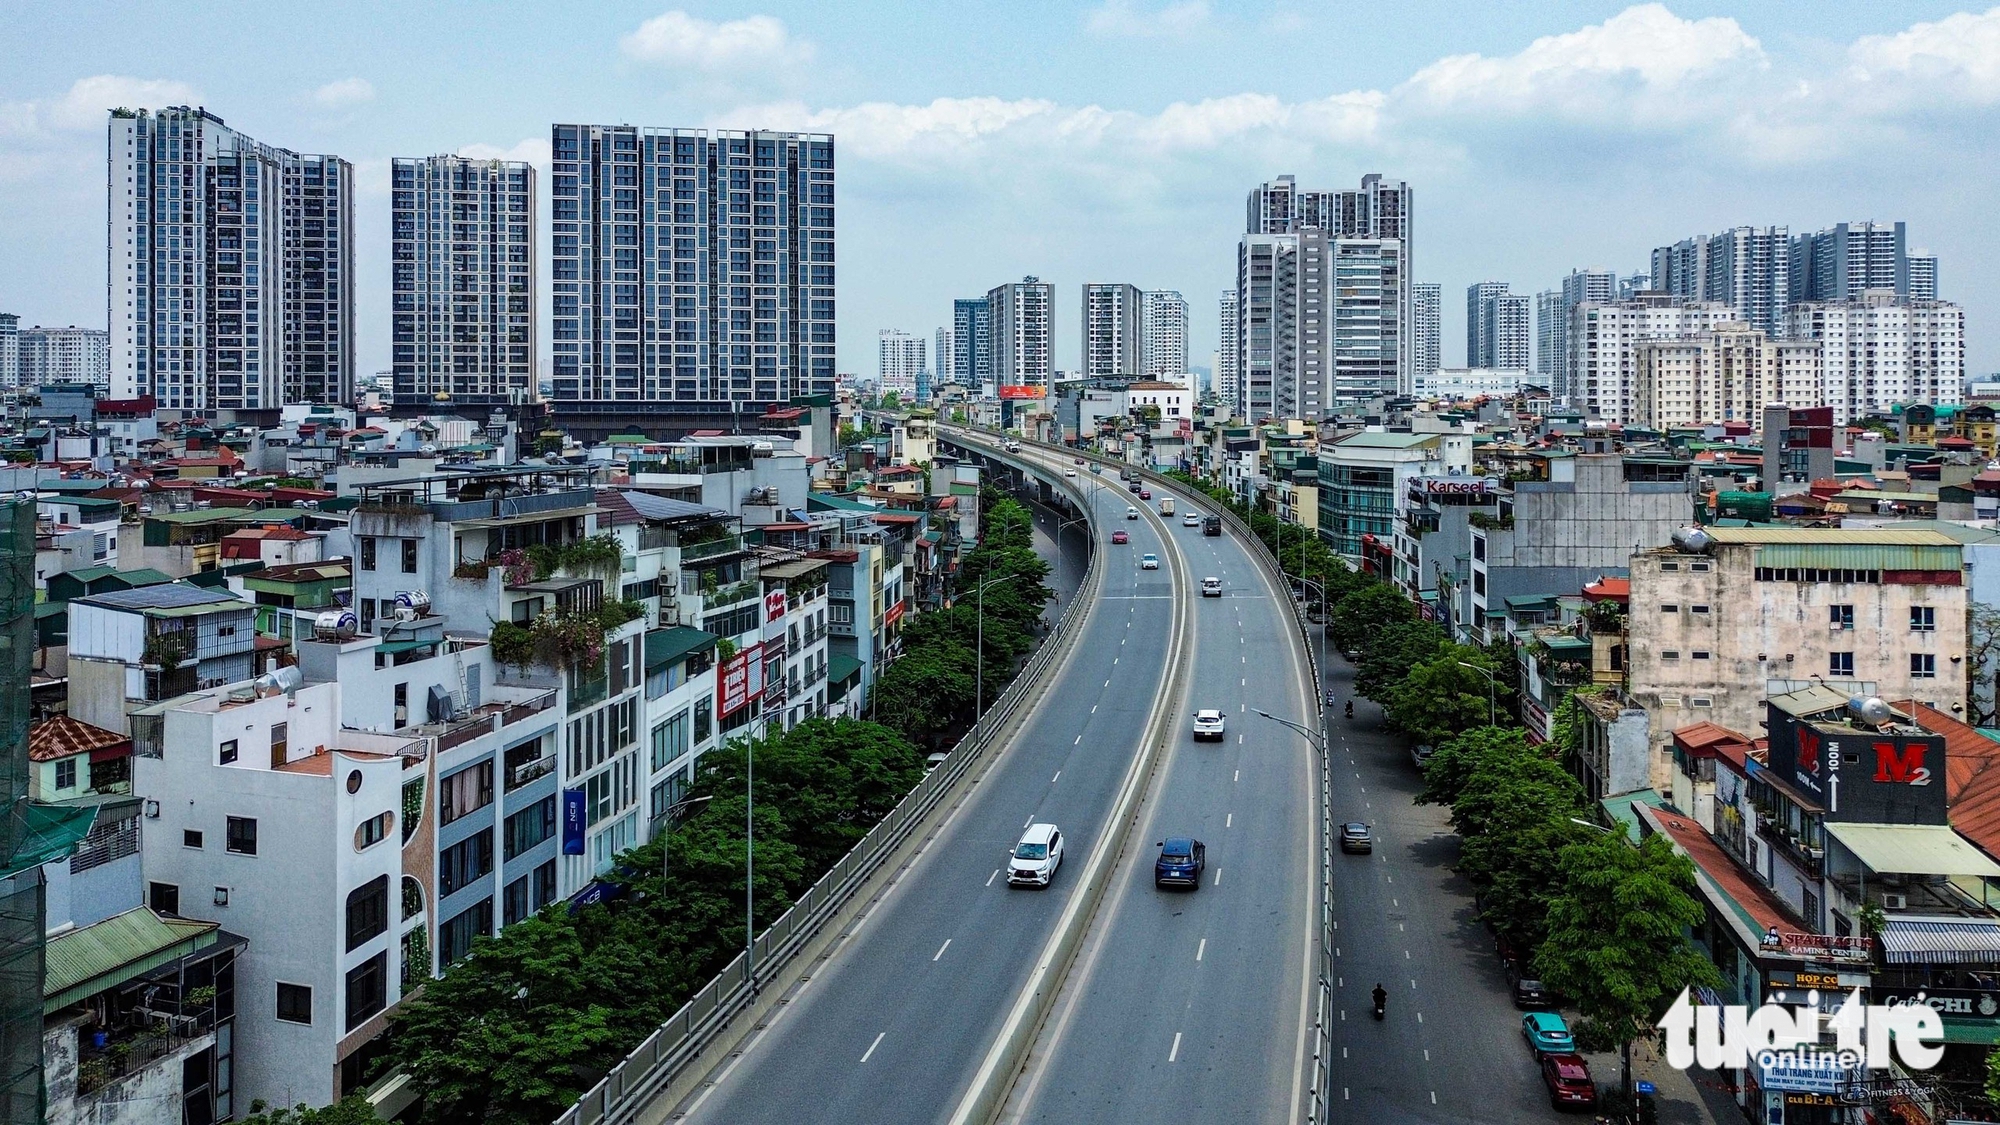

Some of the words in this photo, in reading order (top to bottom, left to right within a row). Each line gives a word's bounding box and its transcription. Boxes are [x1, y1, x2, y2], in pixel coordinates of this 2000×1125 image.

[1427, 480, 1484, 493] Karseell
[1829, 742, 1839, 771] 100M
[1790, 946, 1828, 956] GAMING
[1831, 949, 1869, 959] CENTER
[1925, 997, 1972, 1013] CHI
[1789, 1069, 1812, 1078] TRANG
[1871, 1088, 1903, 1097] FITNESS
[1912, 1086, 1935, 1095] YOGA
